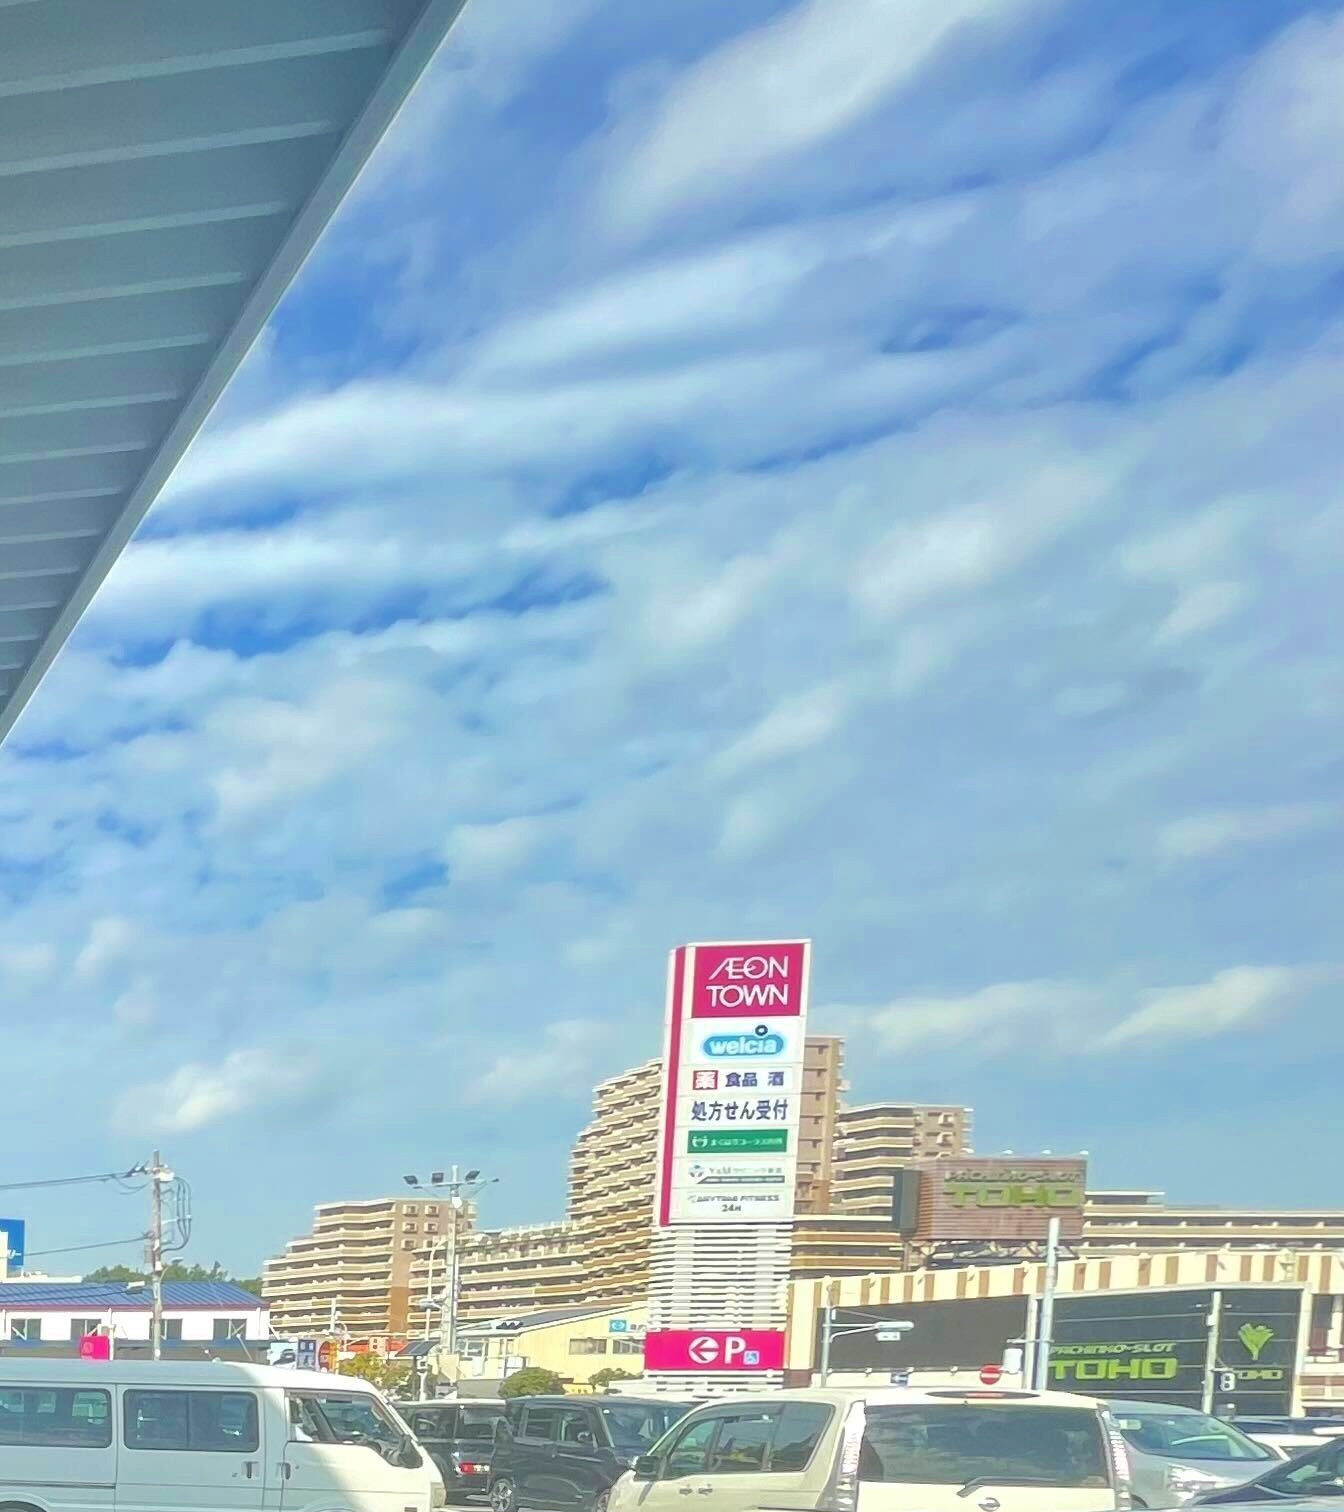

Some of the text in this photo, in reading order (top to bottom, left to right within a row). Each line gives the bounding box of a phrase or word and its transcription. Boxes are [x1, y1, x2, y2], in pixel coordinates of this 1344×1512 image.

[705, 983, 789, 1008] TOWN
[709, 1027, 778, 1056] welcia
[725, 1072, 758, 1087] 食品
[768, 1071, 785, 1086] 酒
[691, 1099, 789, 1121] 処方せん受付
[724, 1336, 746, 1364] P
[1048, 1357, 1177, 1380] TOHO
